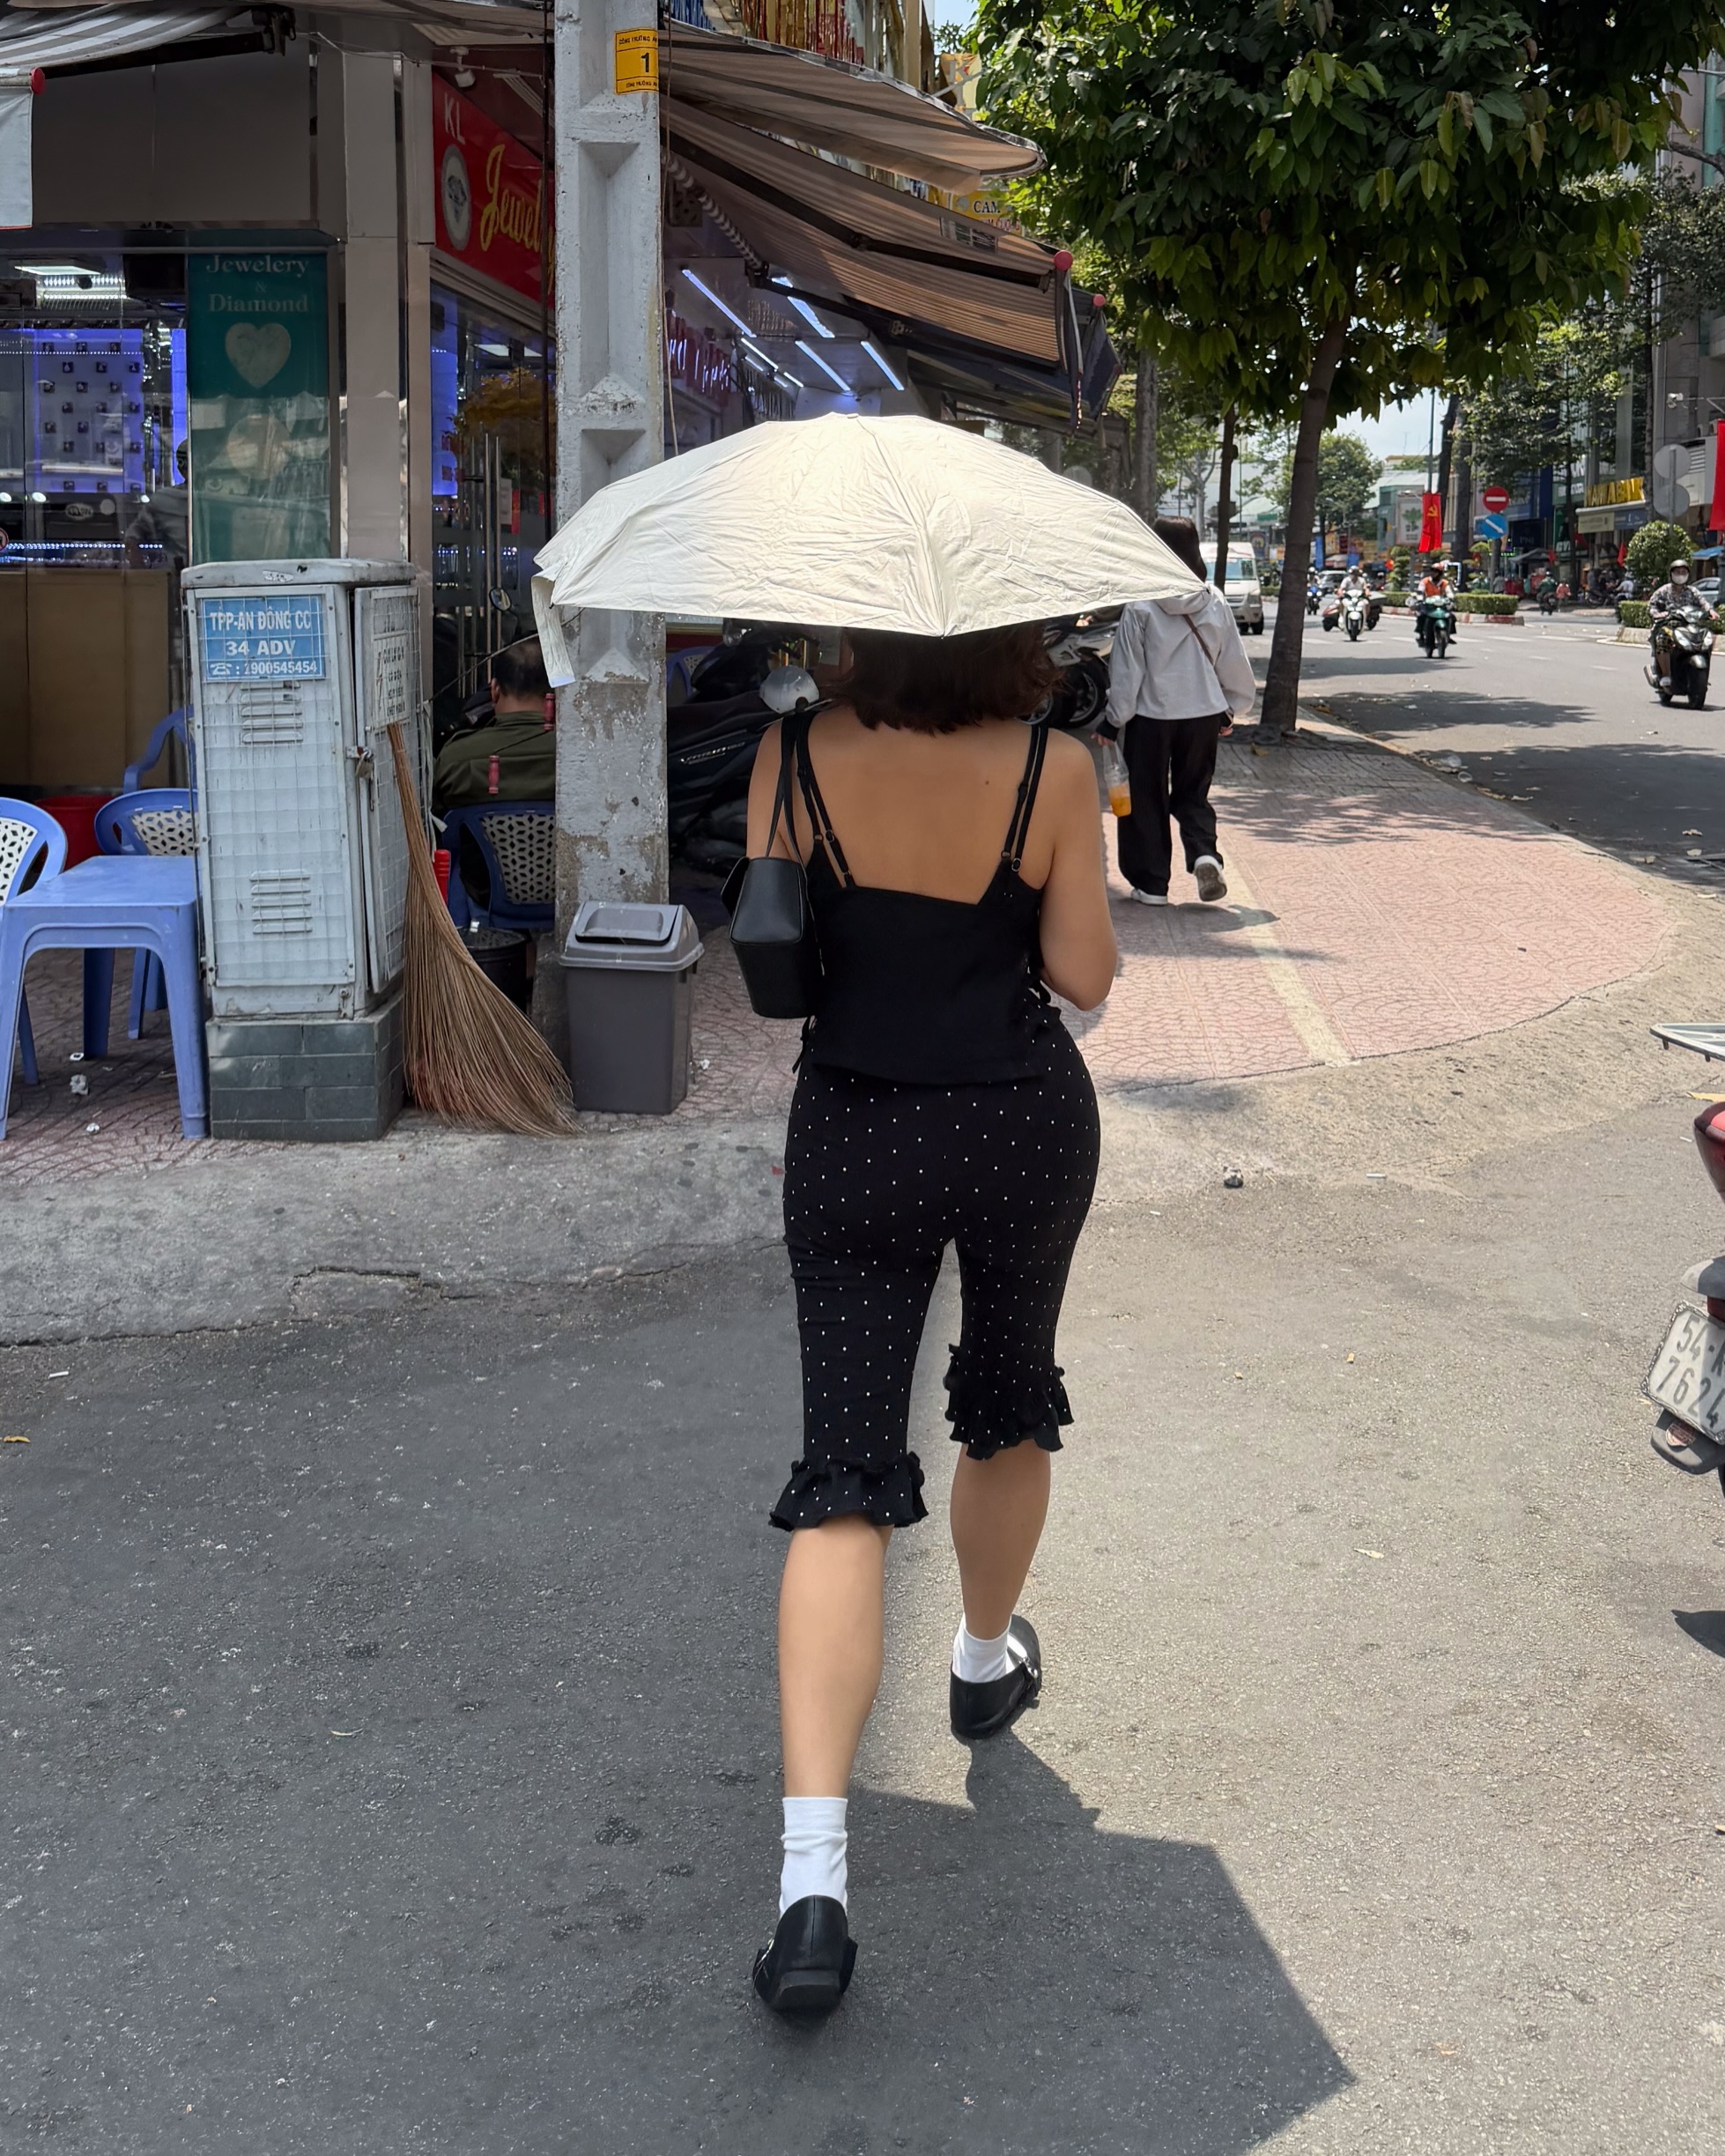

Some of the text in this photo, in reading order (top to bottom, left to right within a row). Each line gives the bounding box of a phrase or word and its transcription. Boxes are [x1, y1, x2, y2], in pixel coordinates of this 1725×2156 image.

[640, 52, 649, 73] 1
[444, 92, 466, 145] KL
[480, 144, 554, 296] Jewely
[206, 255, 308, 278] Jewelery
[255, 281, 267, 293] &
[209, 293, 309, 313] Diamond
[257, 605, 292, 630] ĐÔNG
[226, 640, 296, 656] 34 ADV
[244, 661, 317, 675] 1900545454
